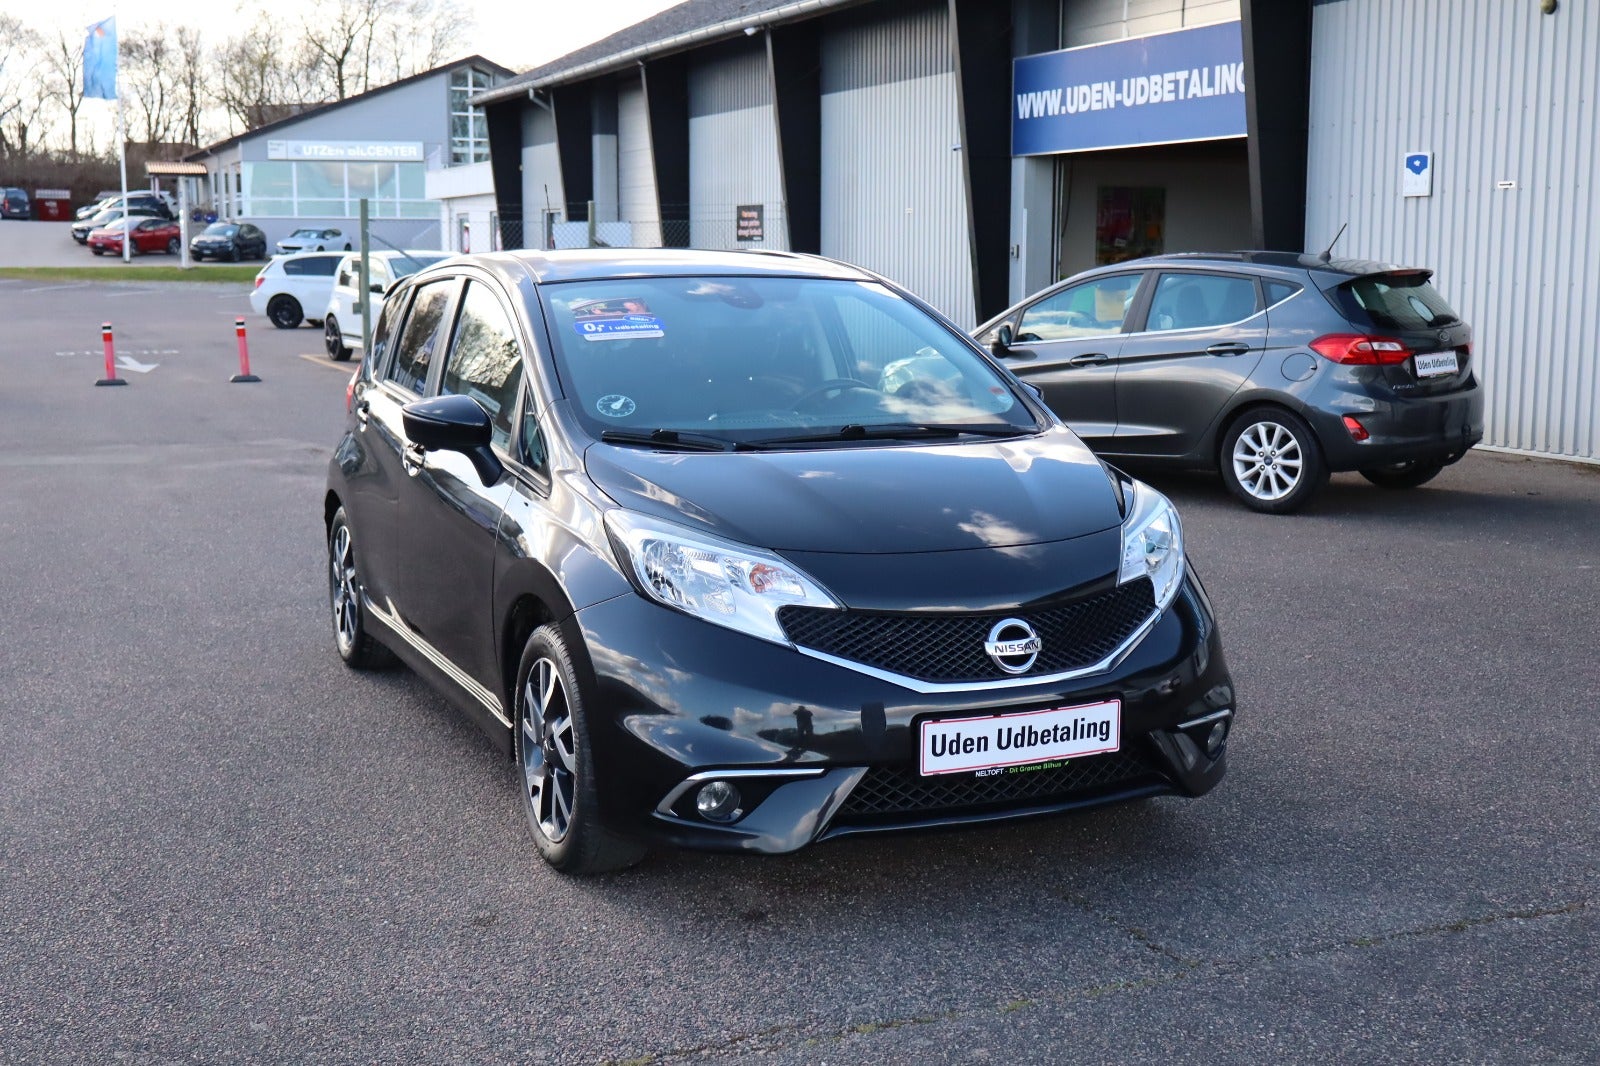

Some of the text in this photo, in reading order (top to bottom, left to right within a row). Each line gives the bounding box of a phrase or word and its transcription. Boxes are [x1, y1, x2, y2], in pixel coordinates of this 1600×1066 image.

[995, 642, 1039, 653] NISSAN
[931, 718, 1111, 757] Uden Udbetaling
[975, 768, 1004, 777] NELTOFT
